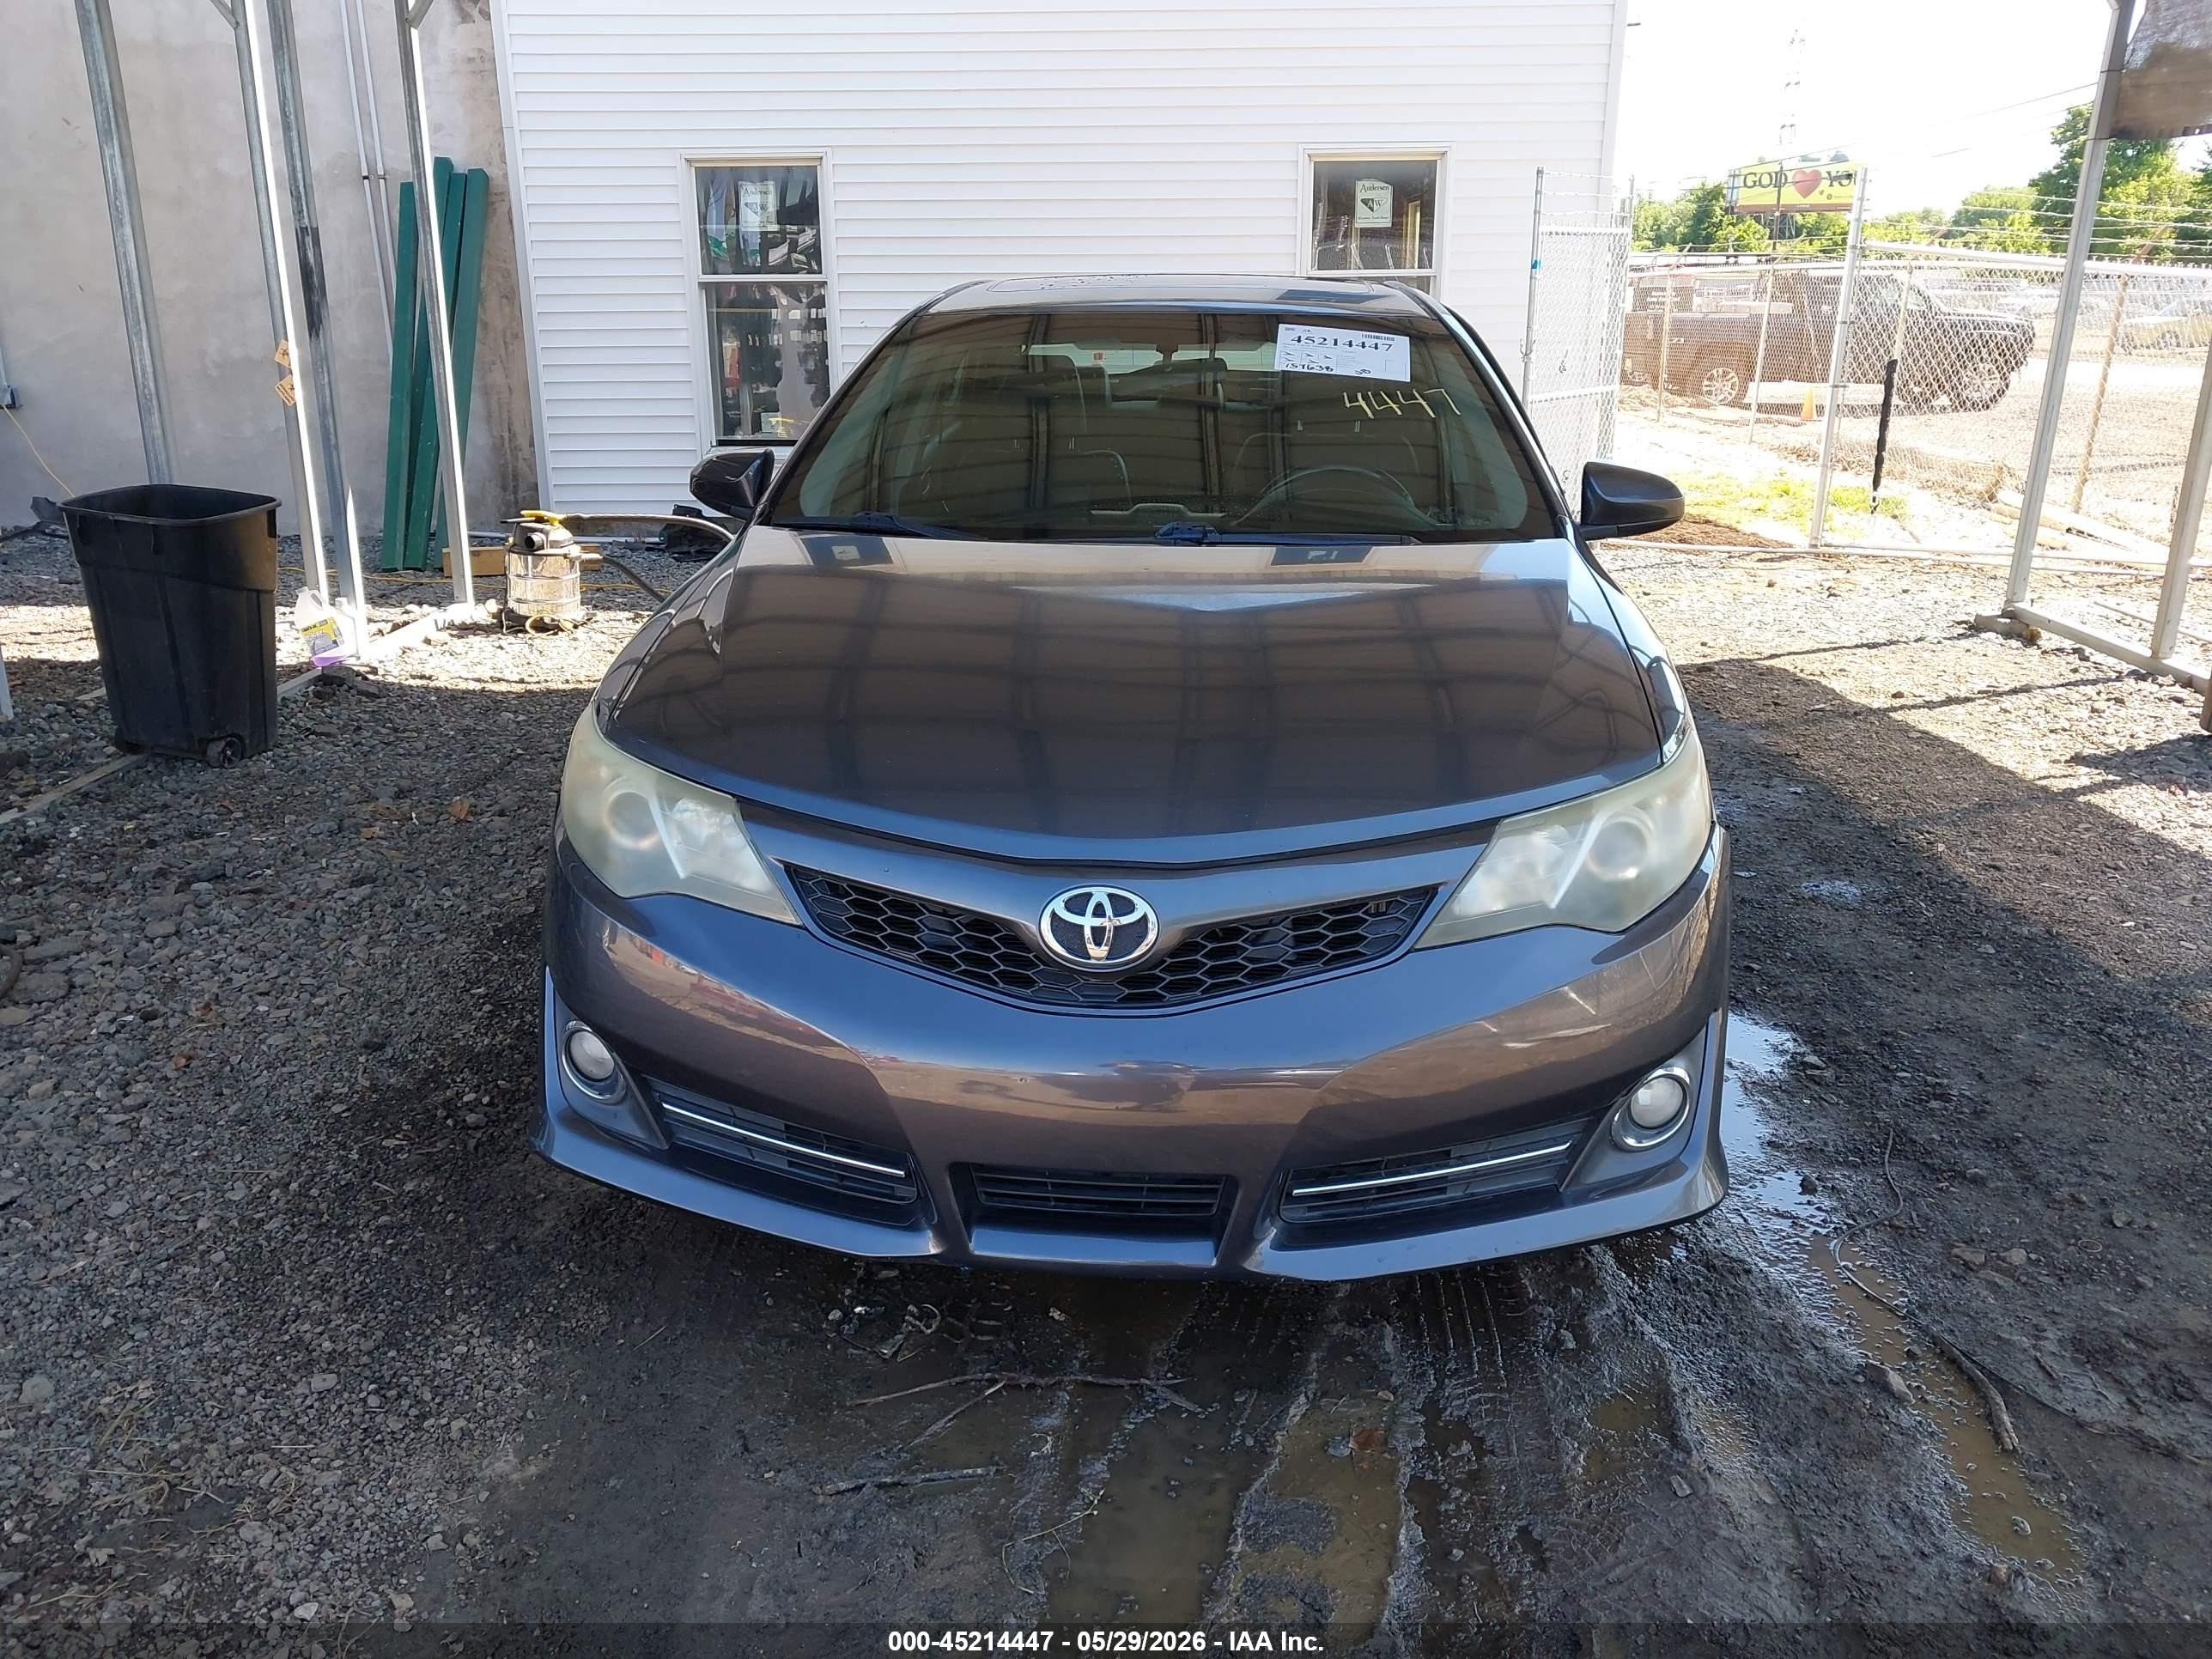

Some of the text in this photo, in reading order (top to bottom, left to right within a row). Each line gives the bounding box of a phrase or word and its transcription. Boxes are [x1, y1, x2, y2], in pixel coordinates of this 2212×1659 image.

[1743, 171, 1788, 188] GOD
[1291, 335, 1394, 352] 45214447
[1343, 388, 1462, 419] 4447
